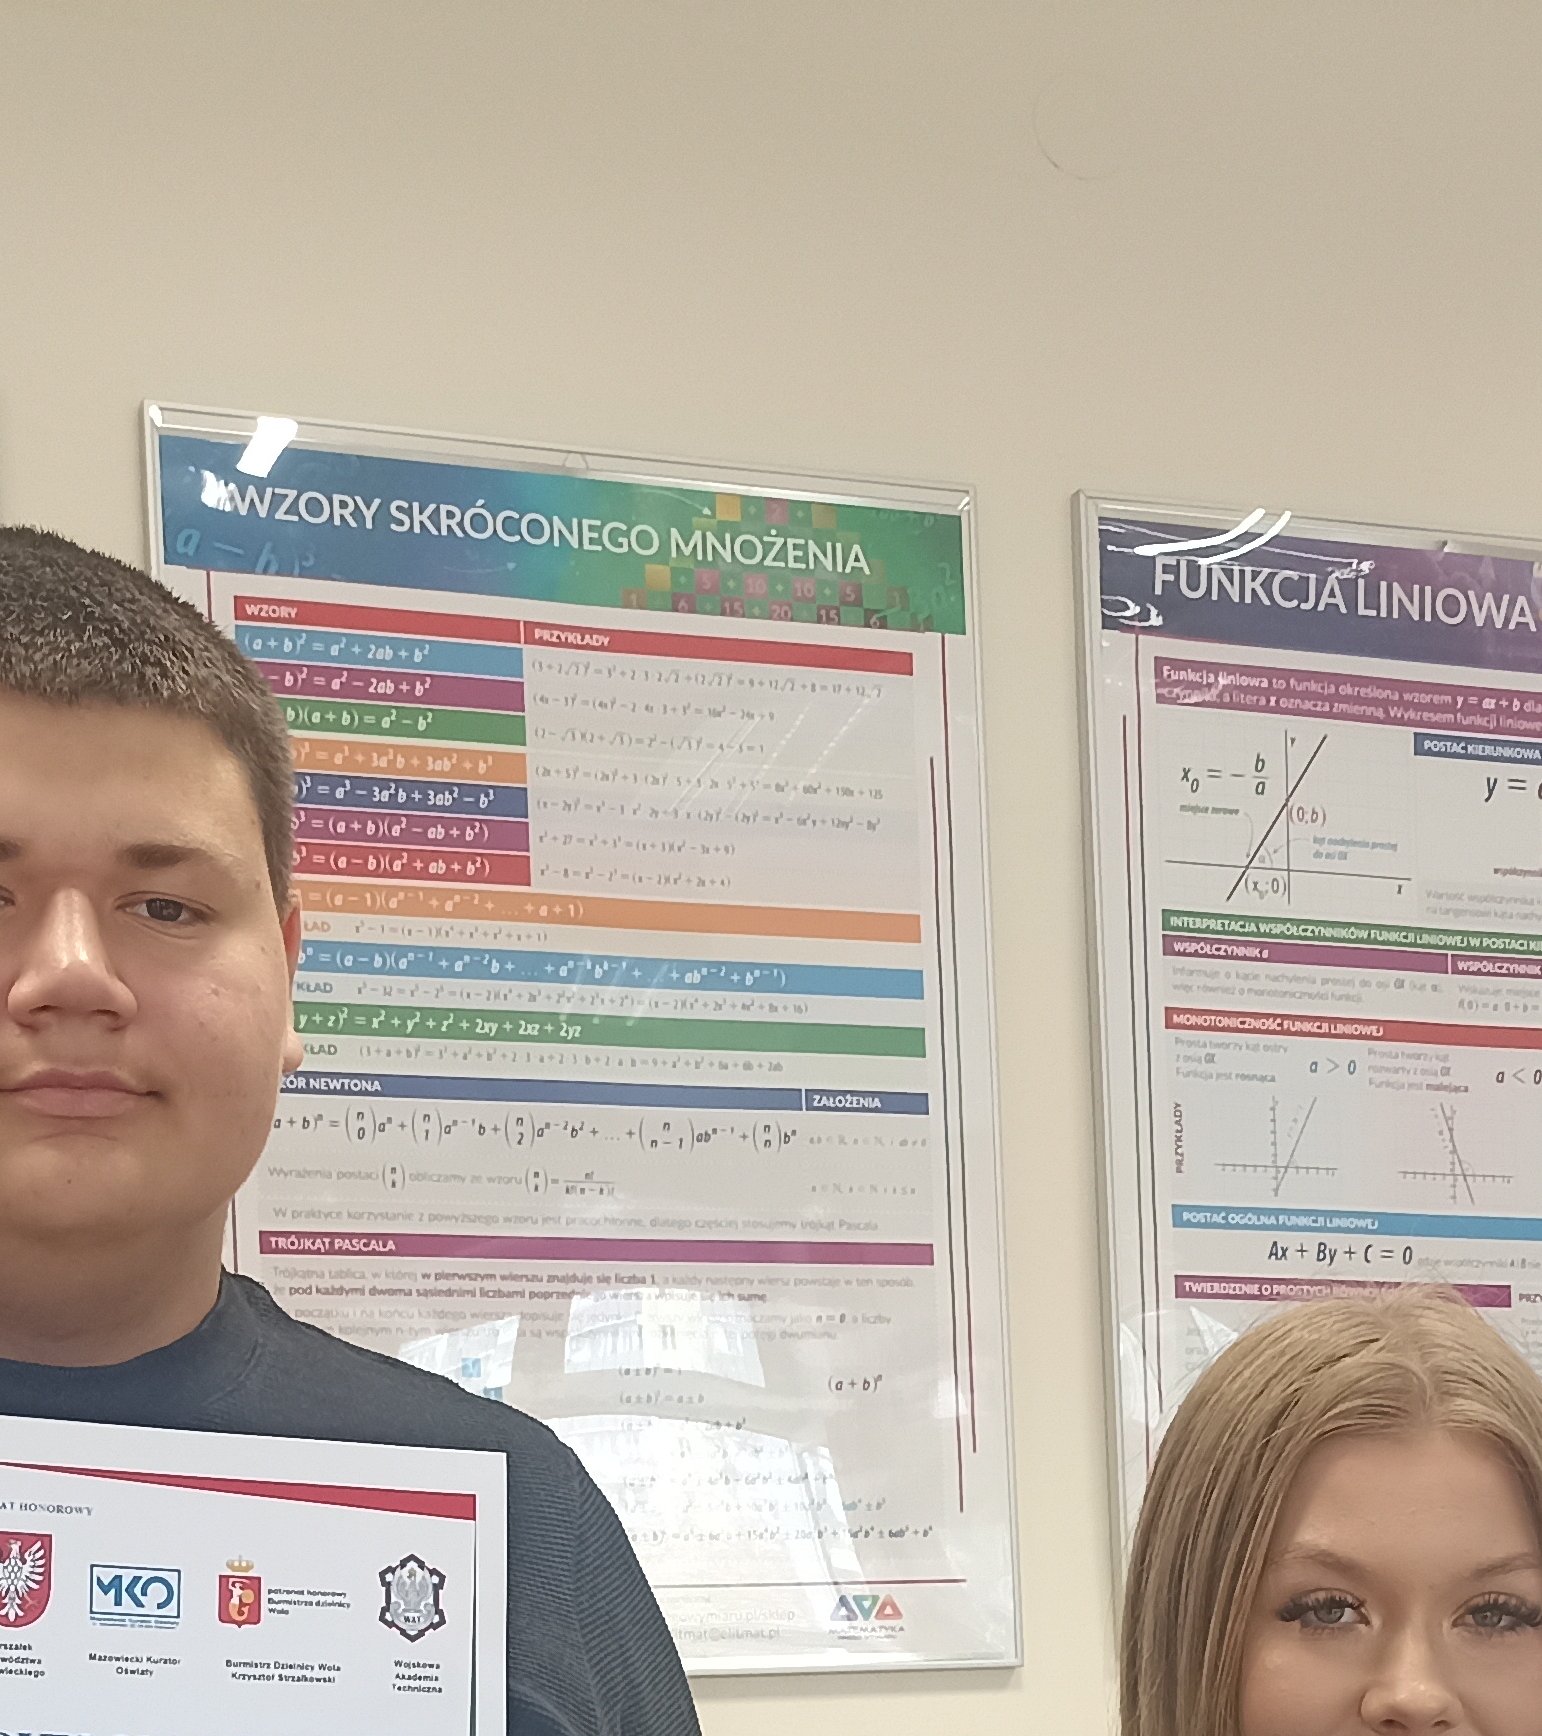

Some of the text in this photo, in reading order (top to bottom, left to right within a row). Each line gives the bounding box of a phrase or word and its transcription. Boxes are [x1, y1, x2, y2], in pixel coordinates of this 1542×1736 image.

[233, 486, 871, 576] WZORY SKRÓCONEGO MNOŻENIA
[1154, 557, 1537, 632] FUNKCJA LINIOWA
[244, 603, 298, 619] WZORY
[534, 628, 610, 647] PRZYKŁADY
[309, 1077, 382, 1092] NEWTONA
[812, 1093, 882, 1109] ZAŁOŻENIA
[1173, 1102, 1186, 1174] PRZYKŁADY
[270, 1235, 396, 1253] TRÓJKĄT PASCALA
[96, 1574, 175, 1610] MKO
